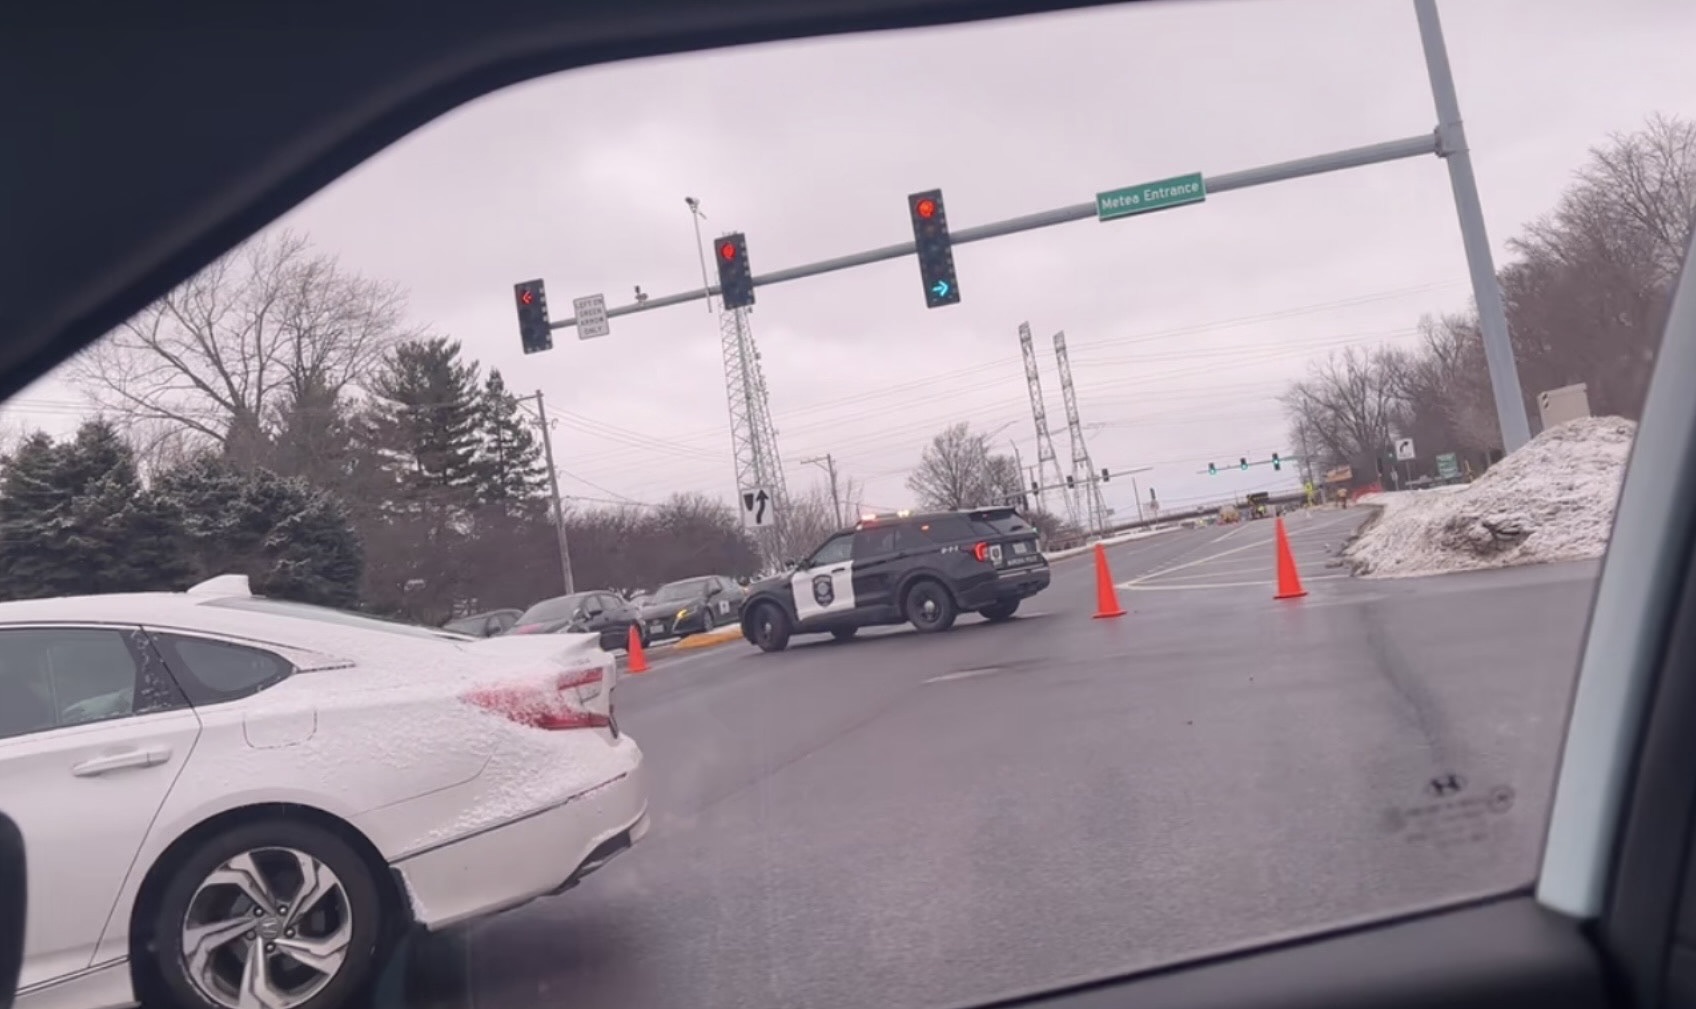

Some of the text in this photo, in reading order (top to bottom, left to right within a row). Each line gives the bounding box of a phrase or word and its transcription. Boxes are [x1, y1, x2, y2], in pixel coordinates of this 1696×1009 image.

[1101, 182, 1199, 210] Metea Entrance
[579, 307, 602, 318] GREEN
[580, 316, 604, 327] ARROW
[584, 326, 602, 335] ONLY
